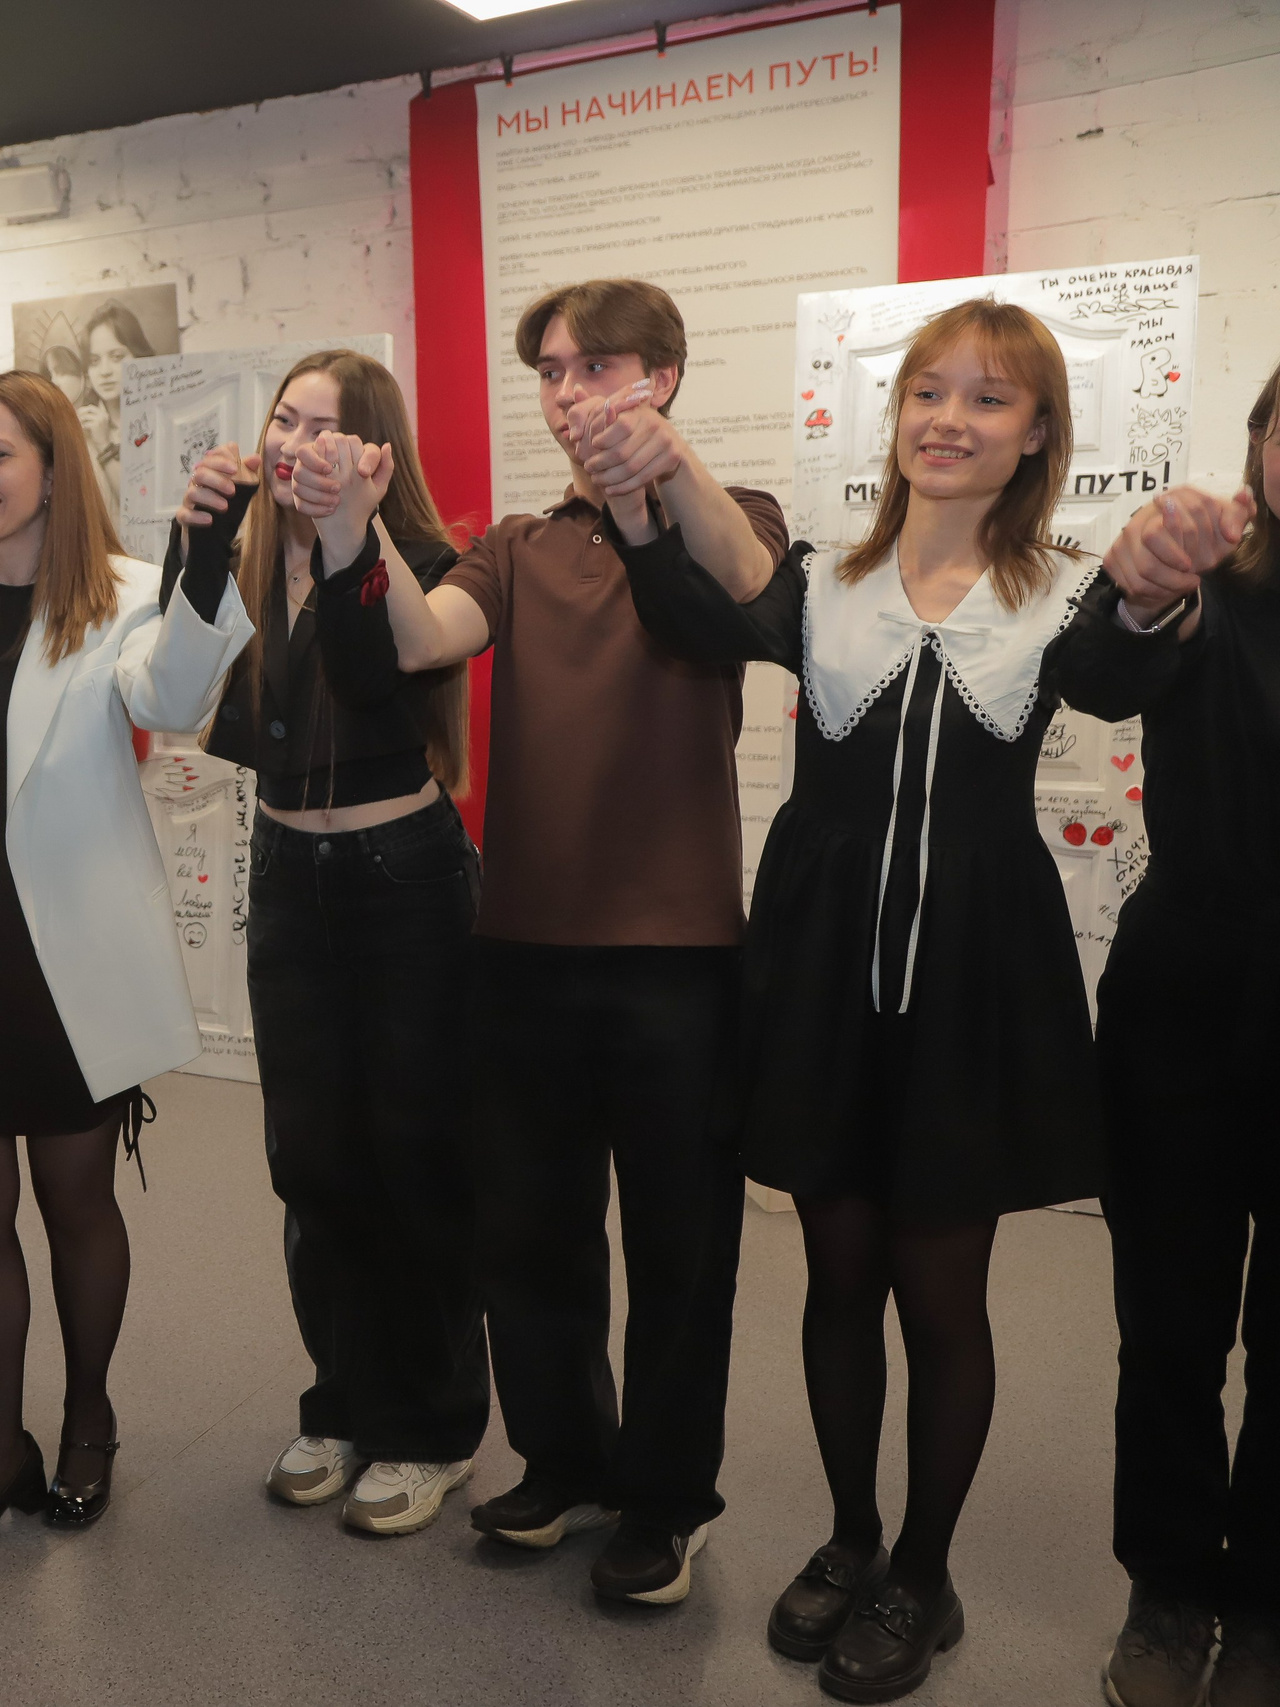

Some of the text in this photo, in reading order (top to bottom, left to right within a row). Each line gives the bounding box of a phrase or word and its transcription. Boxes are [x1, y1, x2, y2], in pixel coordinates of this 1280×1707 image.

[497, 46, 878, 137] МЫ НАЧИНАЕМ ПУТЬ!
[760, 103, 783, 115] ЭТИМ
[785, 89, 867, 111] ИНТЕРЕСОВАТЬСЯ
[1039, 278, 1059, 290] ТЫ
[1068, 270, 1117, 285] ОЧЕНЬ
[1058, 280, 1179, 301] УЛЫБАЙСЯ ЧАЩЕ
[1139, 317, 1163, 331] МЫ
[1131, 333, 1175, 347] РЯДОМ
[1129, 446, 1147, 463] КТО
[1074, 461, 1170, 495] ПУТЬ!
[185, 823, 198, 842] Я
[1107, 834, 1145, 870] ХОЧУ
